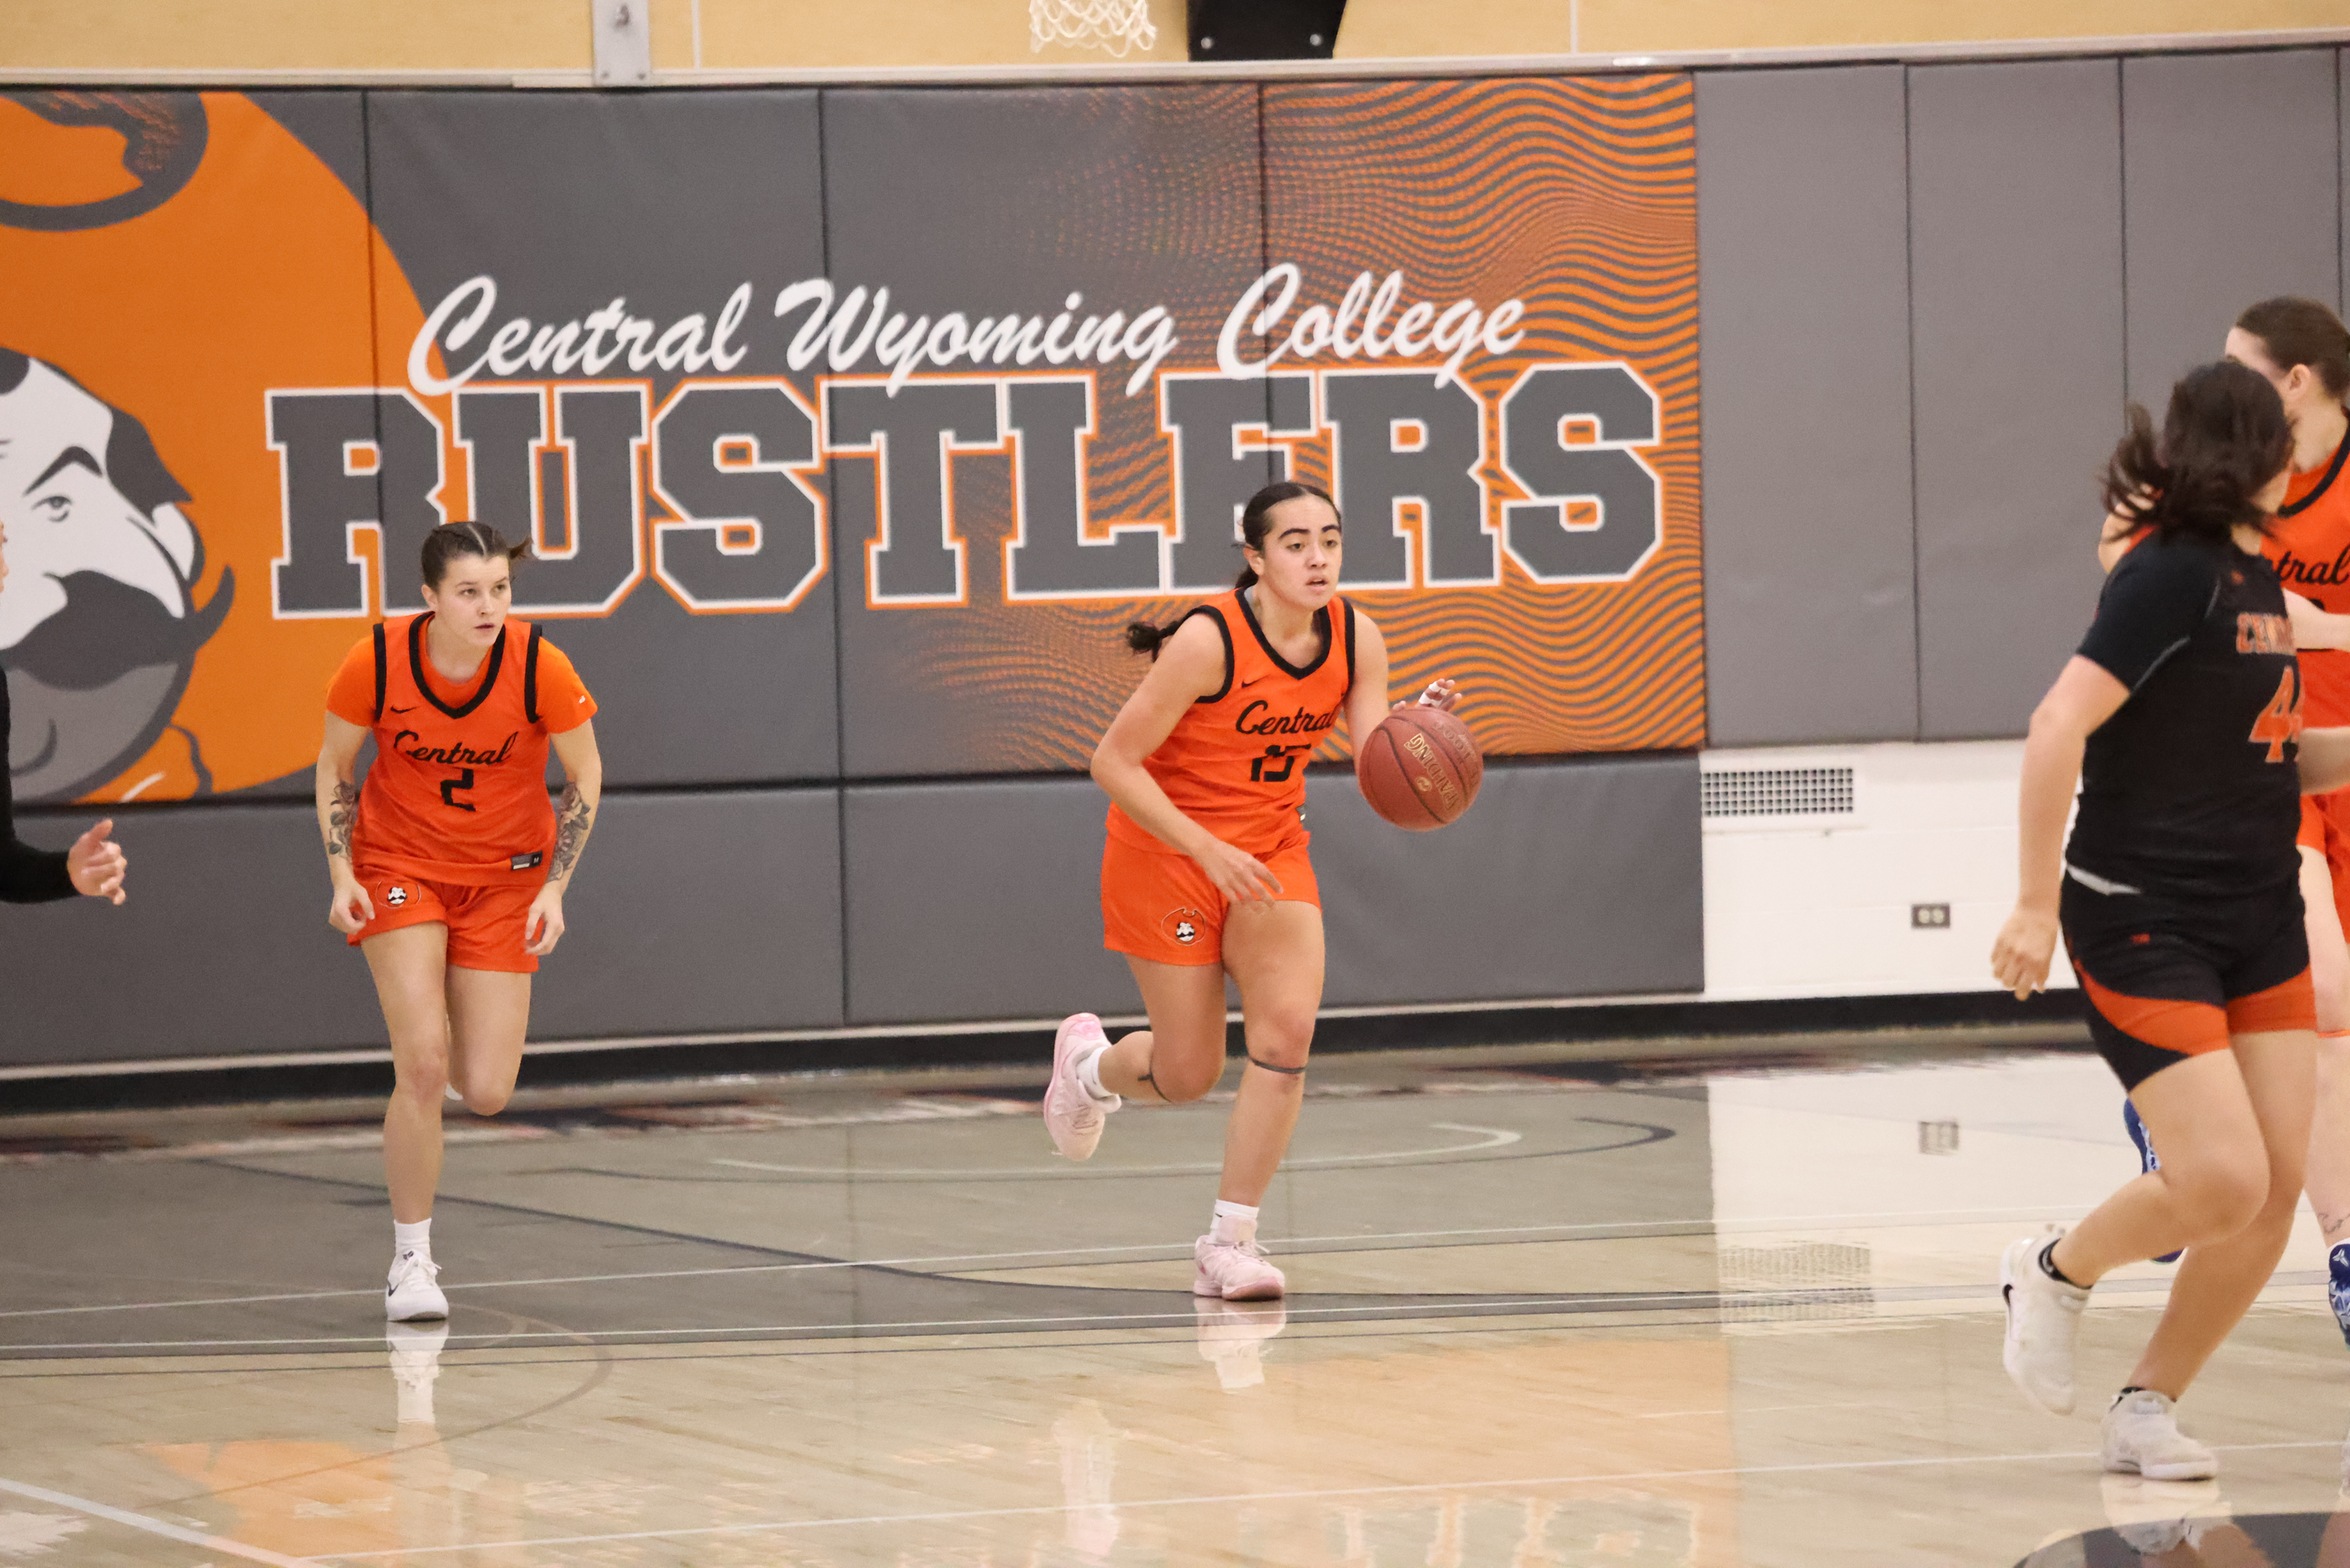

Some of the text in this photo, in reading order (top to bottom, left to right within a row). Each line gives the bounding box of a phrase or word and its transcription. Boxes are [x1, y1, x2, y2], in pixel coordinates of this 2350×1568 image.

[407, 262, 1526, 396] Central Wyoming College
[264, 361, 1662, 619] RUSTLERS
[1236, 700, 1342, 735] Central
[393, 729, 519, 765] Central
[440, 769, 476, 812] 2
